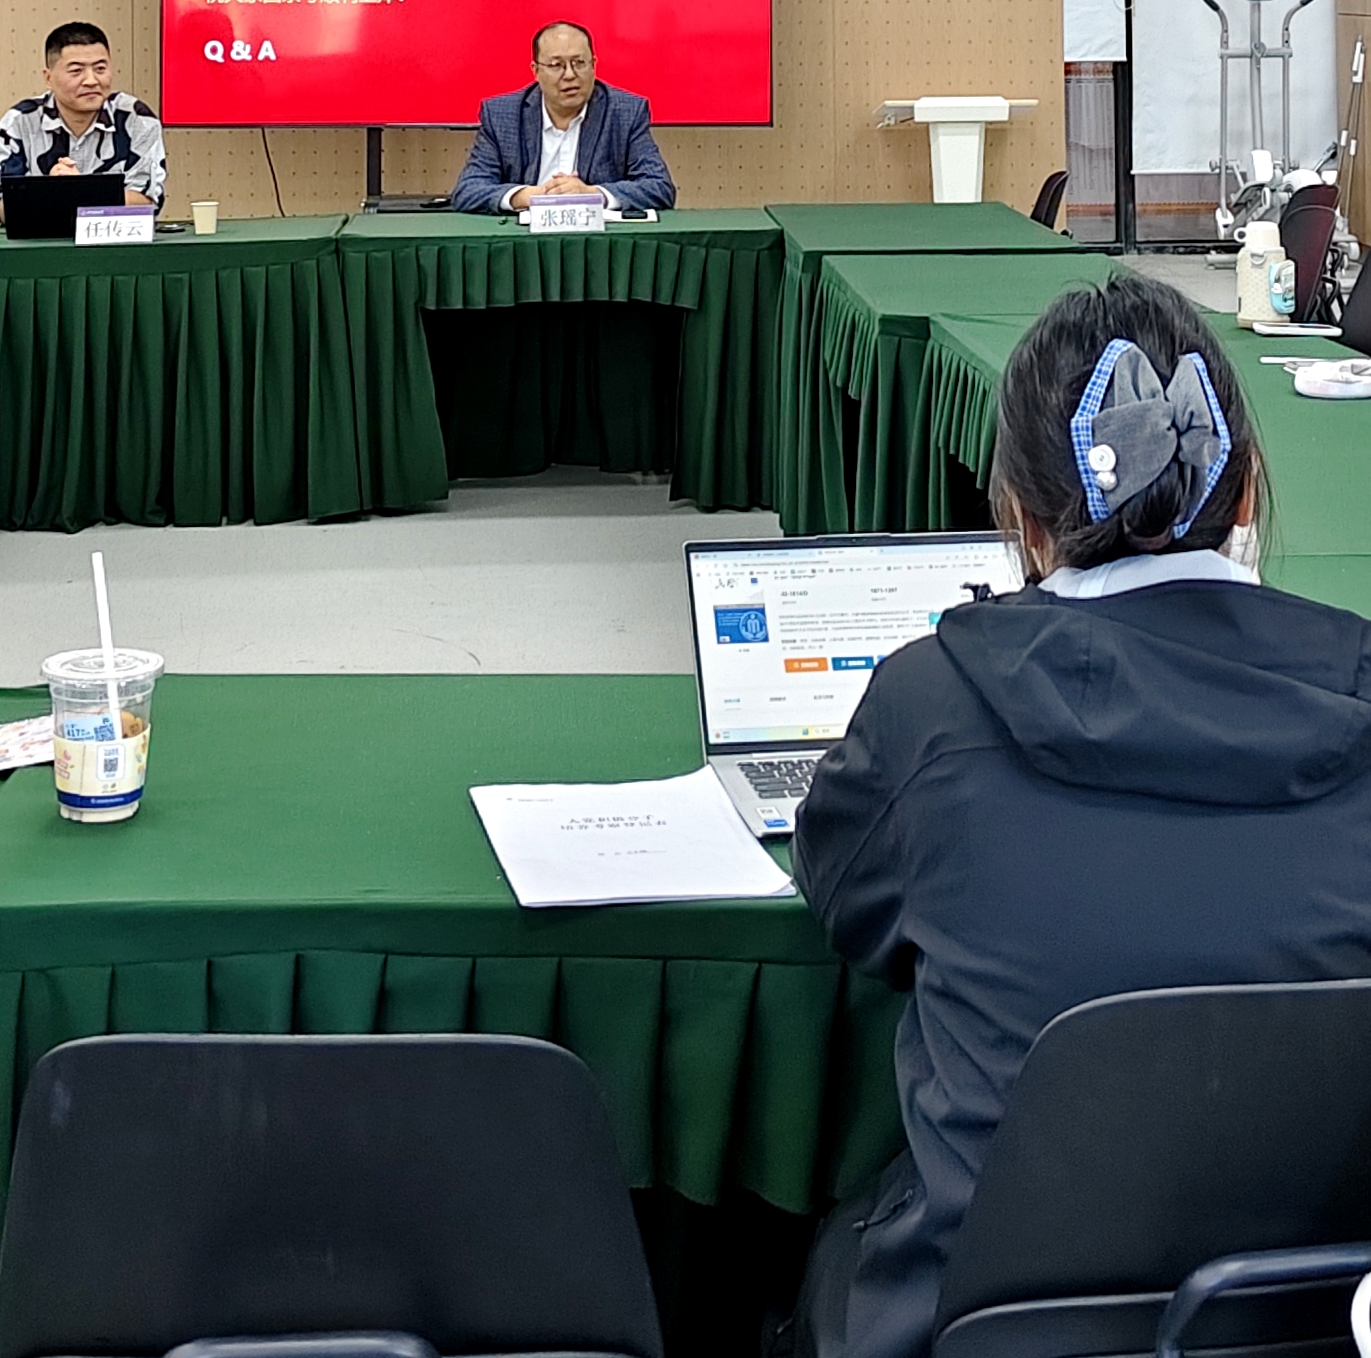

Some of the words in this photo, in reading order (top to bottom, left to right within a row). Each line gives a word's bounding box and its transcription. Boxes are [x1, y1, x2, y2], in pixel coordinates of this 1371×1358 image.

[204, 40, 225, 63] Q
[230, 40, 252, 61] &
[257, 40, 277, 61] A
[83, 220, 144, 239] 任传云
